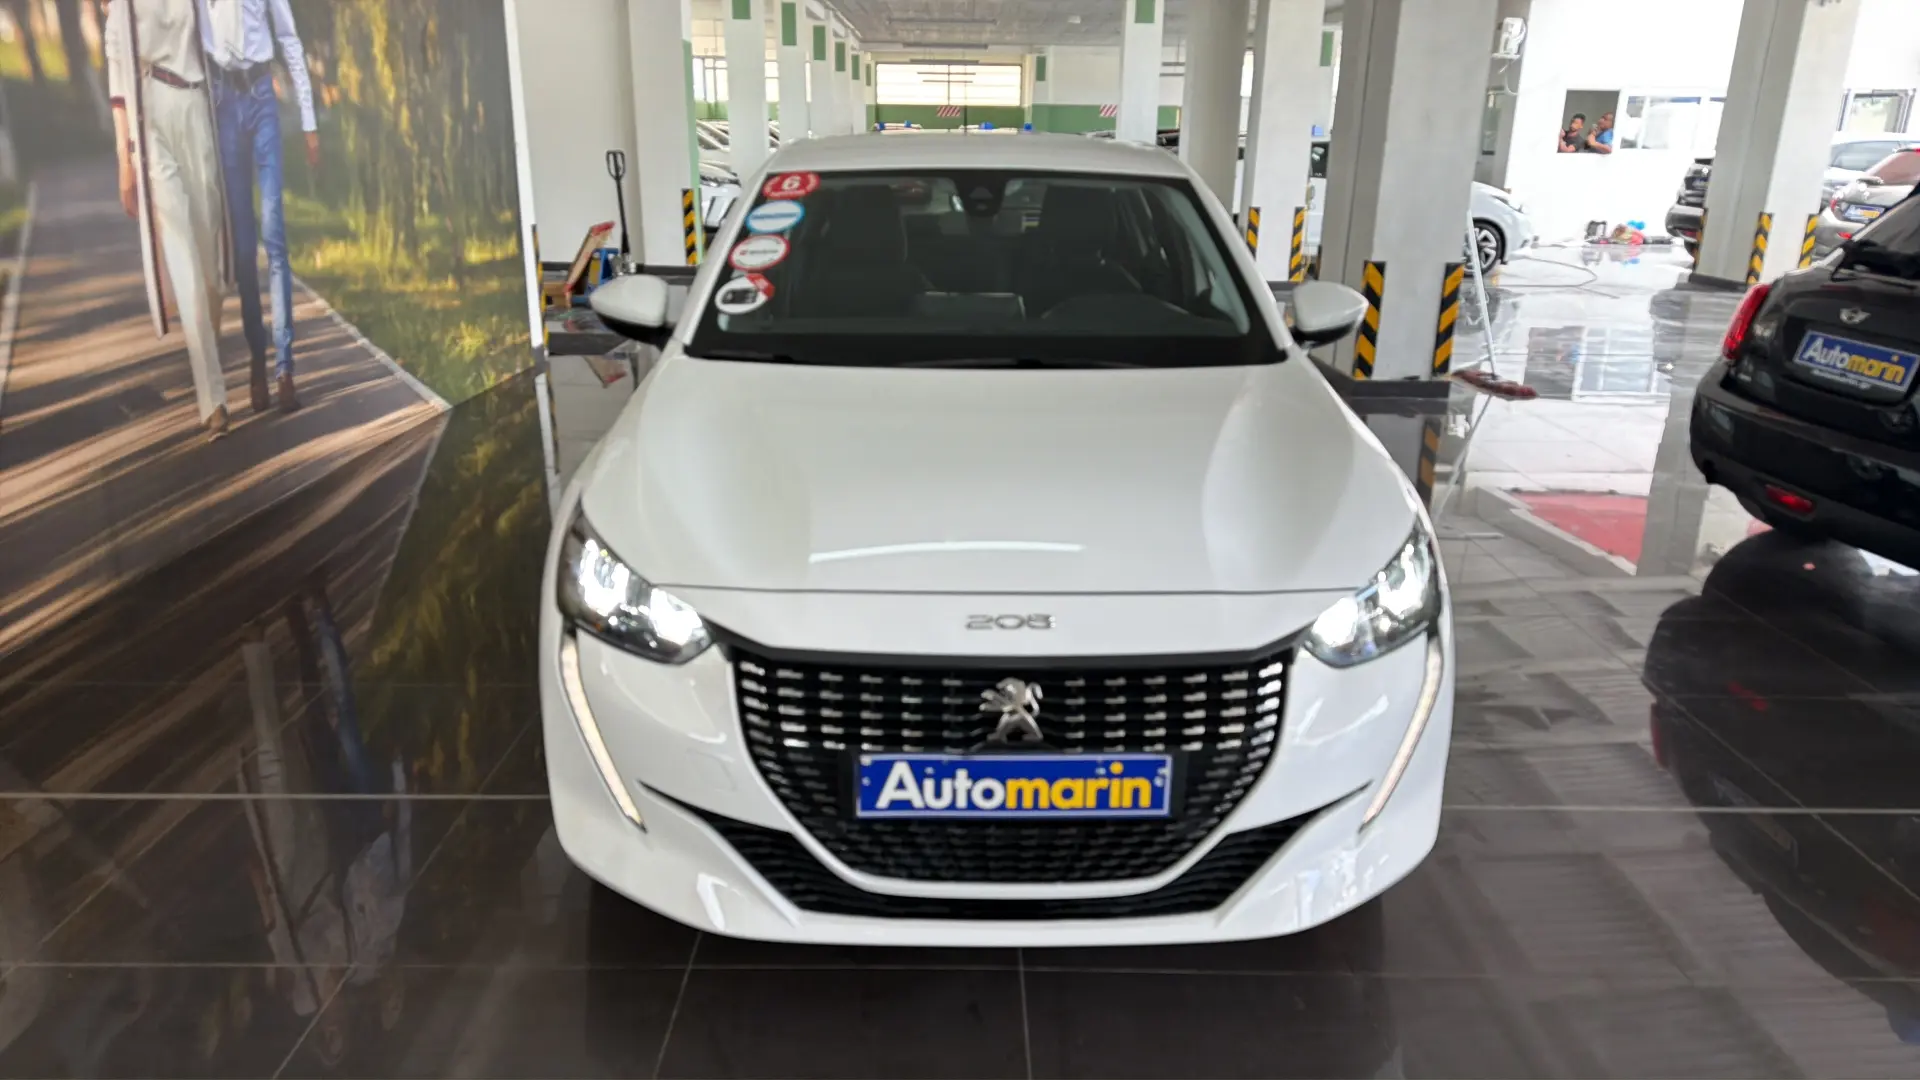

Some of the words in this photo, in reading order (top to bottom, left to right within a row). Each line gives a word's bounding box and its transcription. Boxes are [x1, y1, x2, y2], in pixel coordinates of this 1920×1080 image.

[782, 175, 801, 191] 6
[1802, 337, 1906, 384] Automarin
[965, 613, 1053, 631] 208
[875, 760, 1152, 809] Automarin
